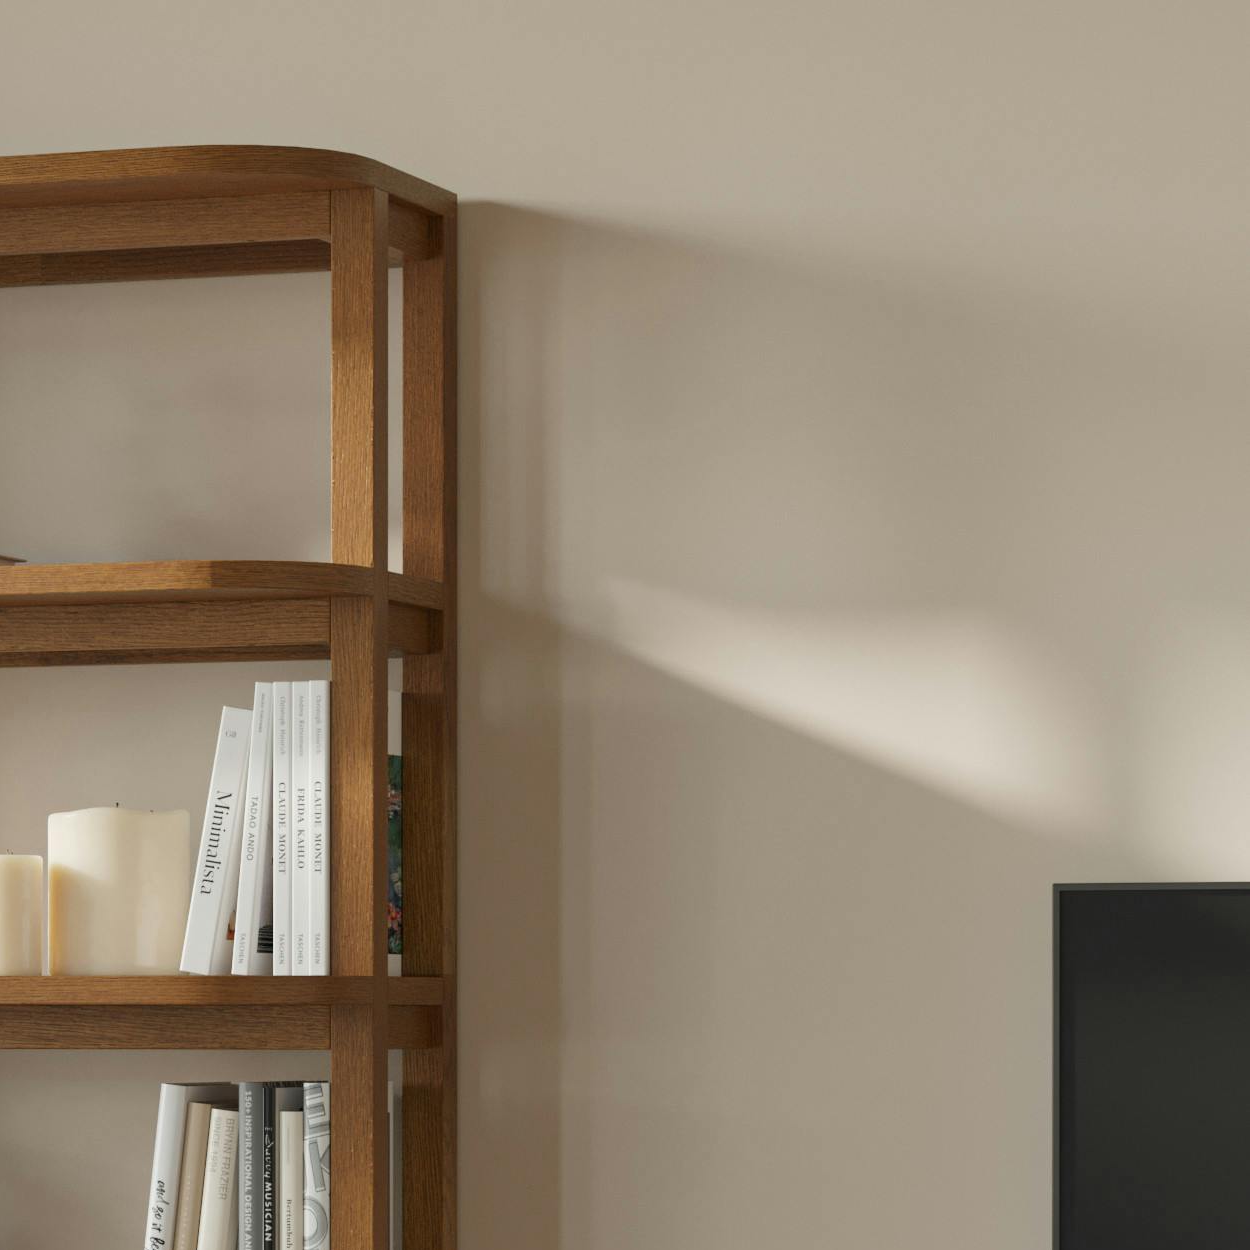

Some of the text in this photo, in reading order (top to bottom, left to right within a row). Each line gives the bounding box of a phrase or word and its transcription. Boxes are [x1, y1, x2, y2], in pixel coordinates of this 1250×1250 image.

[200, 790, 232, 894] Minimalista
[246, 797, 259, 861] TADAO ANDO
[278, 782, 286, 873] CLAUDE MONET
[297, 788, 305, 869] FRIDA KAHLO
[314, 781, 322, 873] CLAUDE MONET
[238, 933, 246, 964] TASCHEN
[244, 1091, 253, 1115] 150+
[218, 1118, 235, 1200] BRYNN FRAZIER
[244, 1116, 253, 1192] INSPIRATIONAL
[156, 1180, 170, 1205] and
[244, 1194, 253, 1231] DESIGN
[264, 1181, 273, 1242] MUSICIAN
[152, 1222, 162, 1233] it
